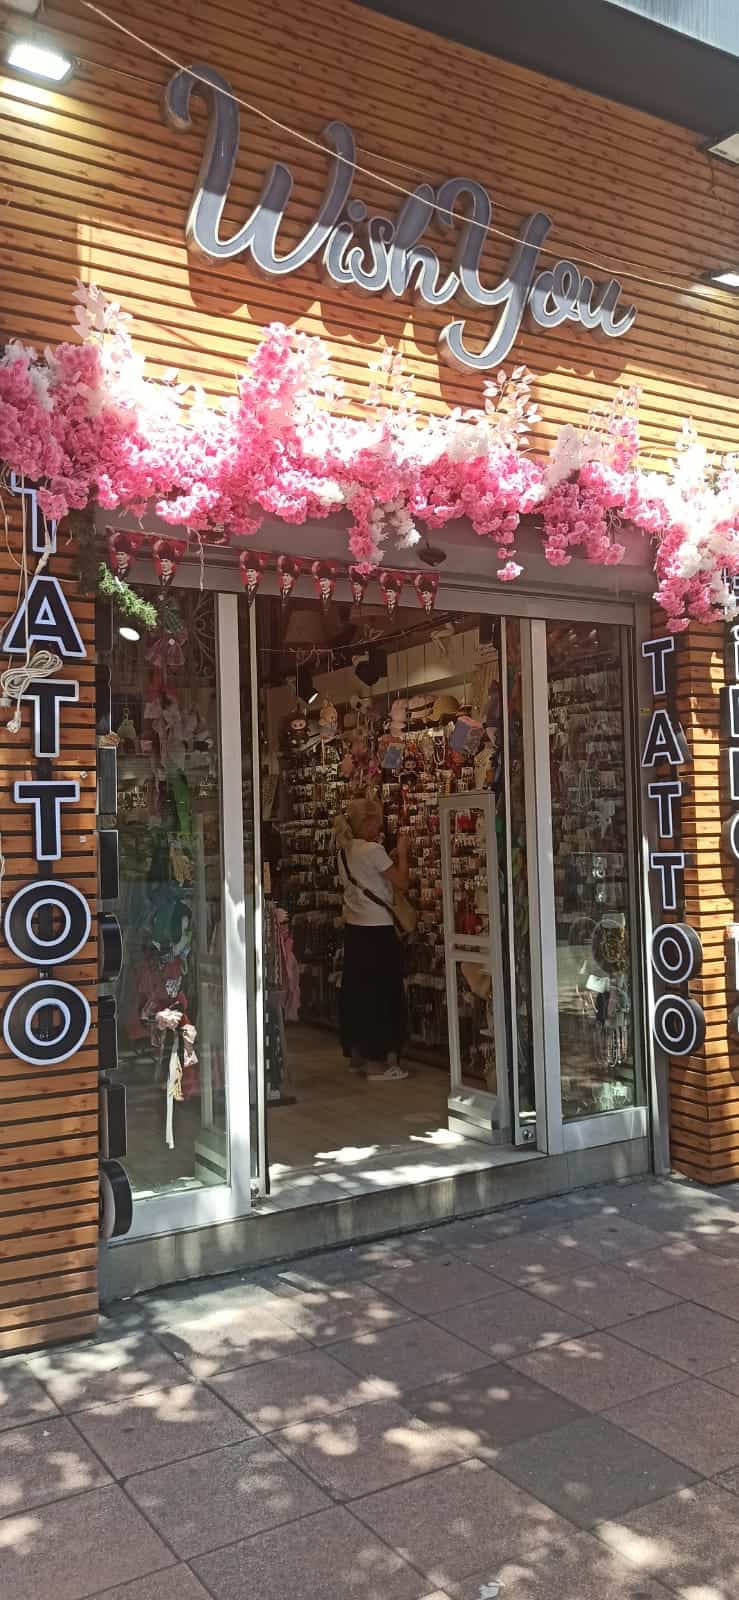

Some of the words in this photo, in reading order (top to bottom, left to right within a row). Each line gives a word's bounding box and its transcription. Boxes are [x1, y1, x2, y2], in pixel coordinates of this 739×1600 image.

[164, 62, 461, 302] Wish
[438, 176, 638, 369] You
[641, 636, 698, 1056] TATTOO
